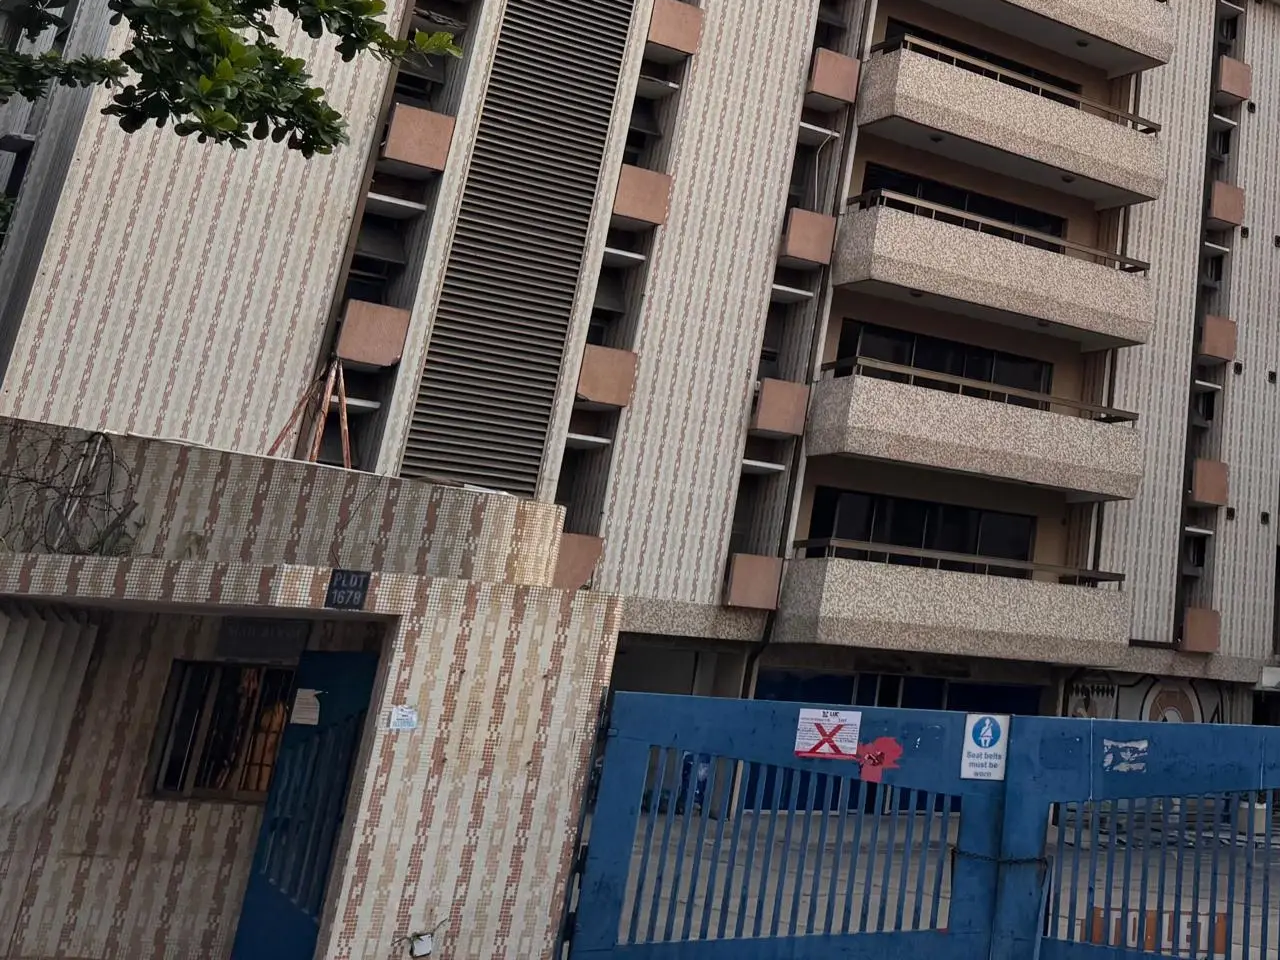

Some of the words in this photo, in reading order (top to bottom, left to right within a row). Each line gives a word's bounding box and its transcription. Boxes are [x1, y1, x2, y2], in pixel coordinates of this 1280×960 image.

[333, 572, 367, 588] PLOT
[967, 751, 983, 759] Seat
[984, 752, 1002, 760] belts
